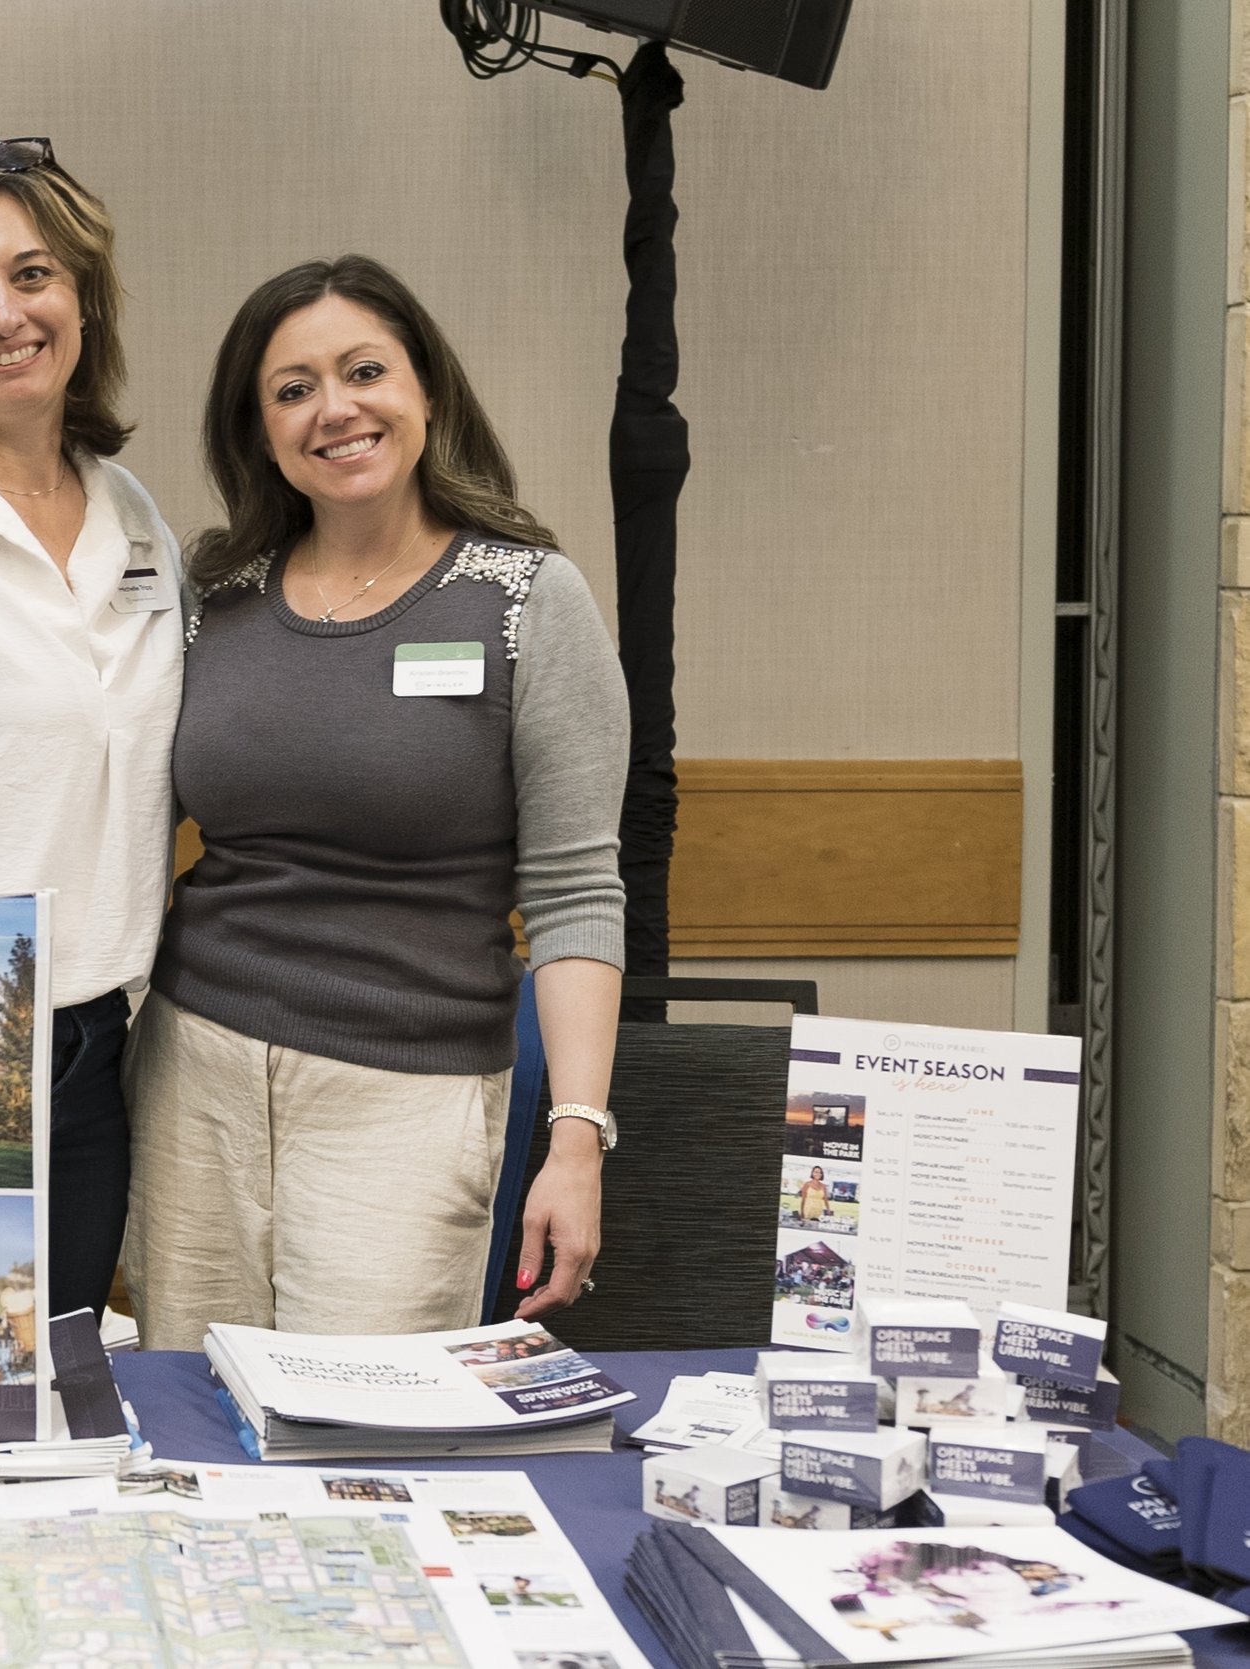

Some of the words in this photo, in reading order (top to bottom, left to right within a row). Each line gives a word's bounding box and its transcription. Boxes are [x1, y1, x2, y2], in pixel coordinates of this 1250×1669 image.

[904, 1039, 943, 1051] PAINTED
[947, 1042, 986, 1054] PRAIRIE
[855, 1054, 919, 1075] EVENT
[923, 1060, 1005, 1081] SEASON
[891, 1076, 909, 1092] is
[913, 1075, 969, 1093] here!
[967, 1107, 995, 1117] JUNE
[823, 1141, 846, 1151] MOVIE
[847, 1143, 859, 1151] IN
[839, 1150, 860, 1159] PARK
[964, 1155, 991, 1164] JULY
[954, 1195, 998, 1204] AUGUST
[942, 1233, 1005, 1246] SEPTEMBER
[905, 1269, 930, 1277] AURORA
[931, 1271, 960, 1279] BOREALIS
[945, 1261, 998, 1273] OCTOBER
[876, 1329, 911, 1342] OPEN
[913, 1330, 952, 1343] SPACE
[1002, 1322, 1036, 1336] OPEN
[1036, 1326, 1074, 1345] SPACE
[875, 1341, 916, 1352] MEETS
[1000, 1334, 1039, 1349] MEETS
[268, 1353, 324, 1366] FIND
[327, 1360, 398, 1371] YOUR
[875, 1351, 919, 1363] URBAN
[919, 1352, 952, 1364] VIBE.
[999, 1345, 1040, 1360] URBAN
[1041, 1351, 1071, 1367] VIBE.
[270, 1360, 419, 1378] TOMORROW
[280, 1368, 359, 1383] HOME
[361, 1376, 440, 1386] TODAY
[1022, 1377, 1054, 1388] OPEN
[773, 1384, 809, 1396] OPEN
[810, 1385, 849, 1397] SPACE
[773, 1395, 813, 1406] MEETS
[1025, 1397, 1061, 1409] RBAN
[1062, 1400, 1091, 1415] VIBE.
[773, 1405, 817, 1417] URBAN
[817, 1406, 849, 1418] VIBE.
[785, 1447, 819, 1461] OPEN
[819, 1452, 855, 1469] SPACE
[936, 1448, 974, 1461] OPEN
[974, 1451, 1014, 1466] SPACE
[785, 1459, 823, 1473] MEETS
[936, 1459, 977, 1472] MEETS
[785, 1469, 825, 1485] URBAN
[825, 1476, 857, 1490] VIBE.
[936, 1469, 982, 1482] URBAN
[982, 1473, 1015, 1487] VIBE.
